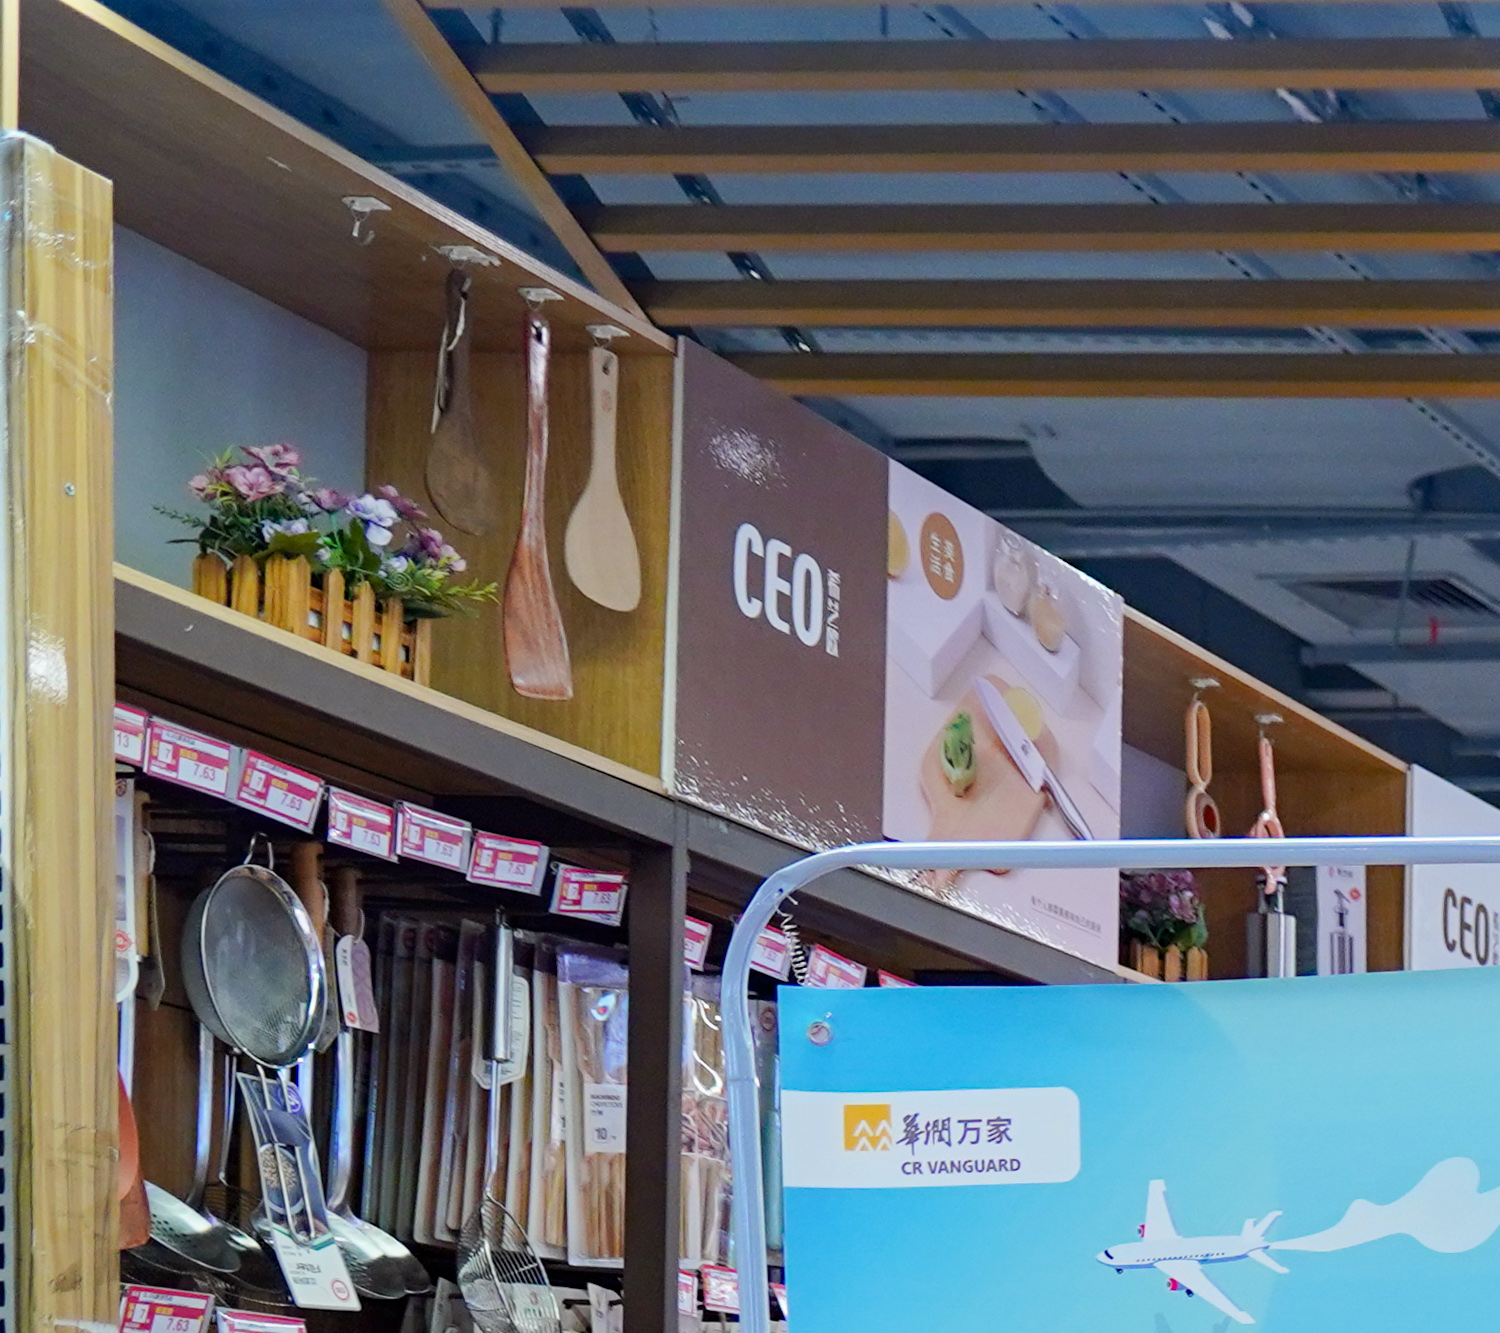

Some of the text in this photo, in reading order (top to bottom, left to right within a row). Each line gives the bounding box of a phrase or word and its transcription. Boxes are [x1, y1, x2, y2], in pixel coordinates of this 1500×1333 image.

[734, 523, 823, 647] CEO
[1442, 887, 1490, 965] CEO
[901, 1157, 1022, 1174] CR VANGUARD
